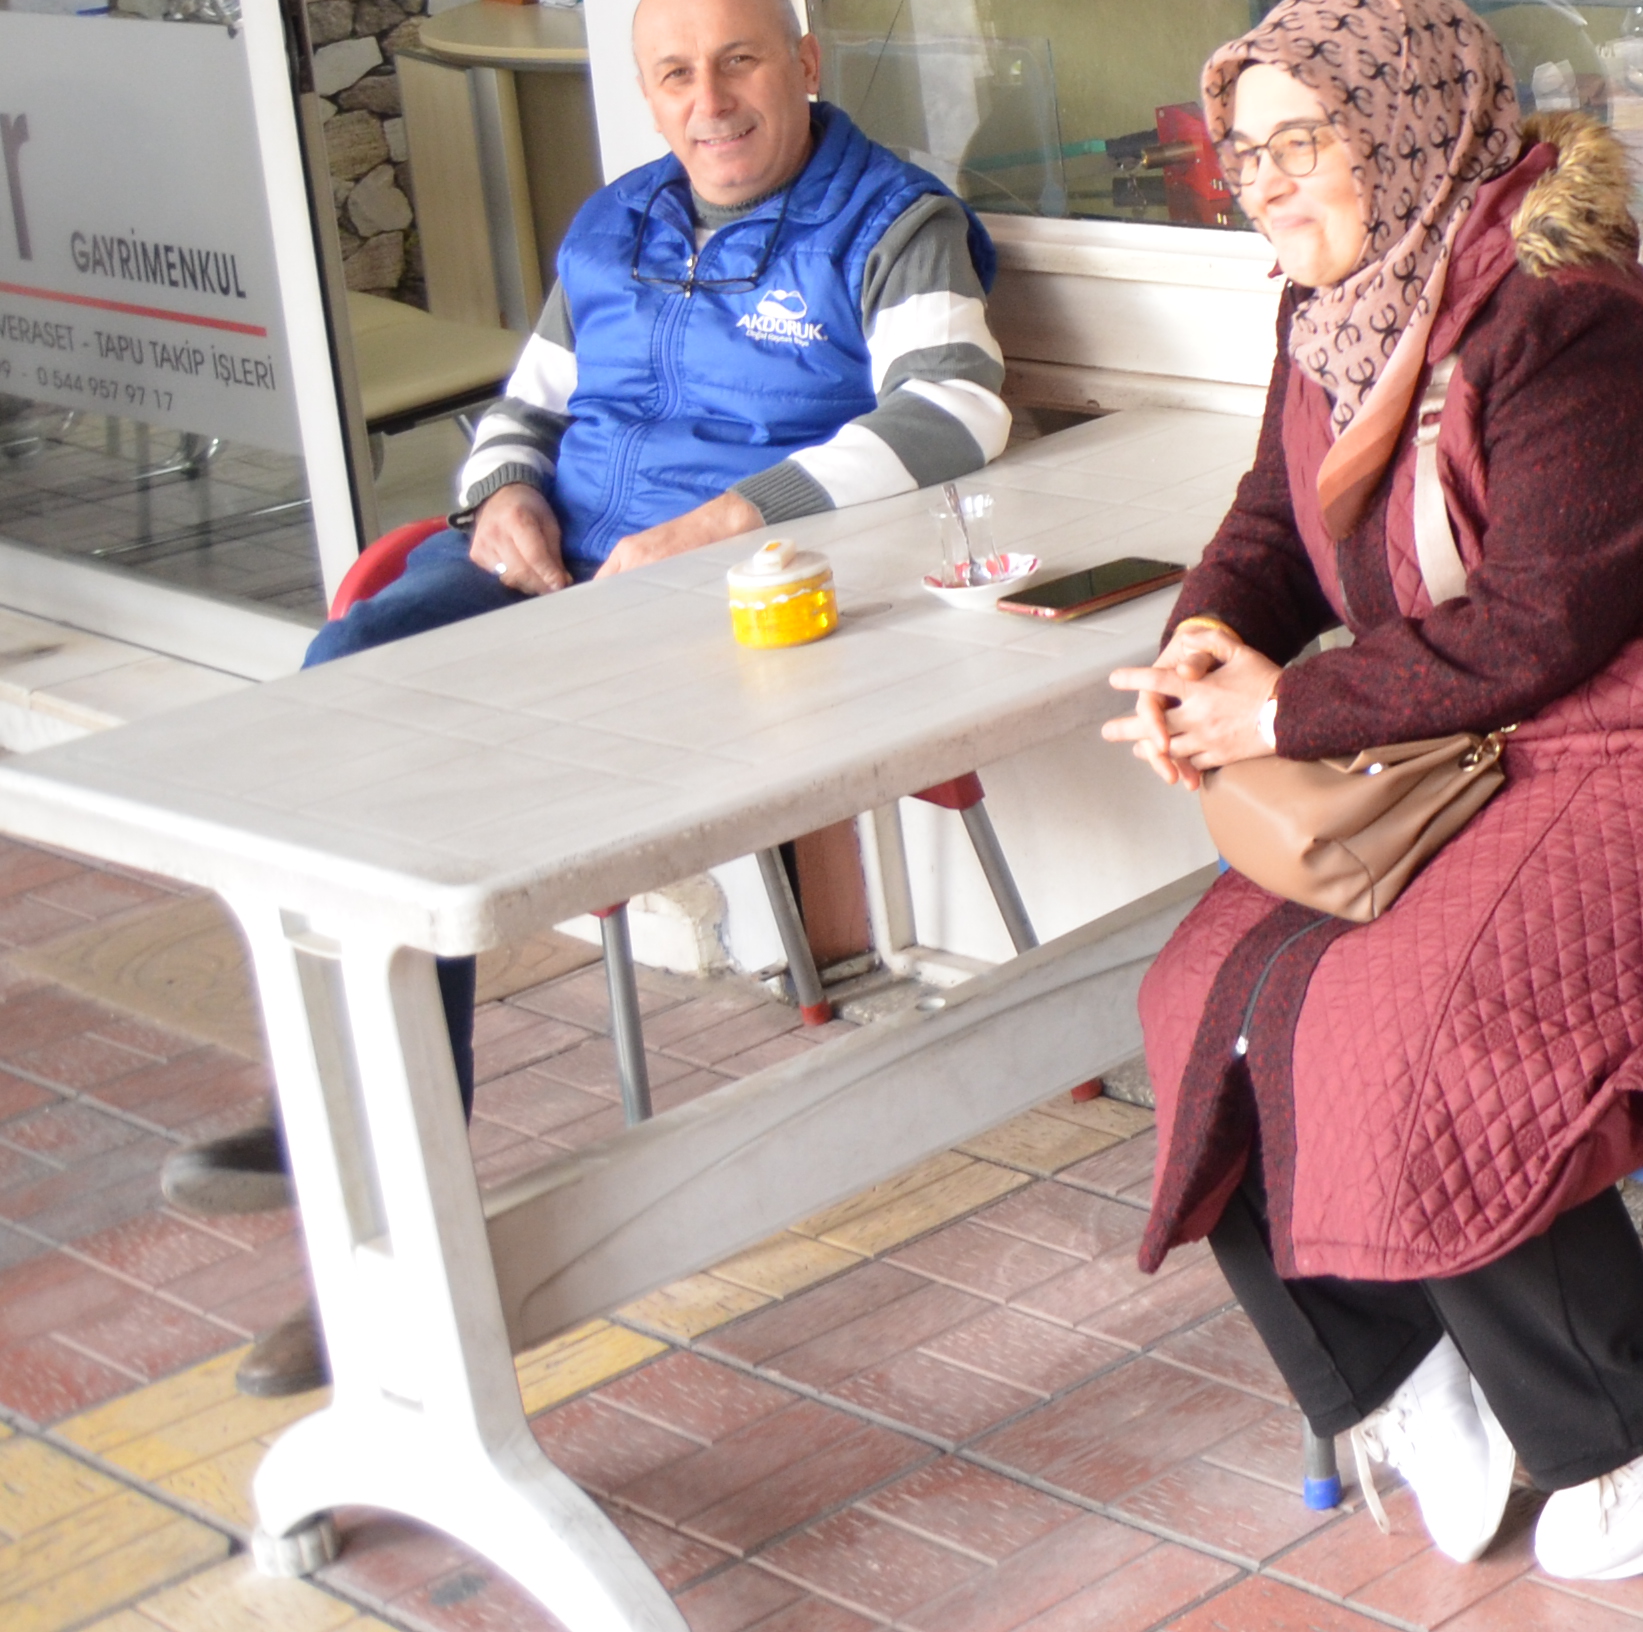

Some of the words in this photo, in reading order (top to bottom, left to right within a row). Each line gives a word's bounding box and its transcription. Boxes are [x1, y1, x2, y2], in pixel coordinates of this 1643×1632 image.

[70, 228, 247, 299] GAYRİMENKUL
[53, 370, 84, 393] 544
[88, 376, 119, 400] 957
[125, 383, 146, 406] 97
[94, 331, 144, 365] TAPU
[148, 340, 205, 376] TAKİP
[211, 344, 276, 391] İŞLERİ
